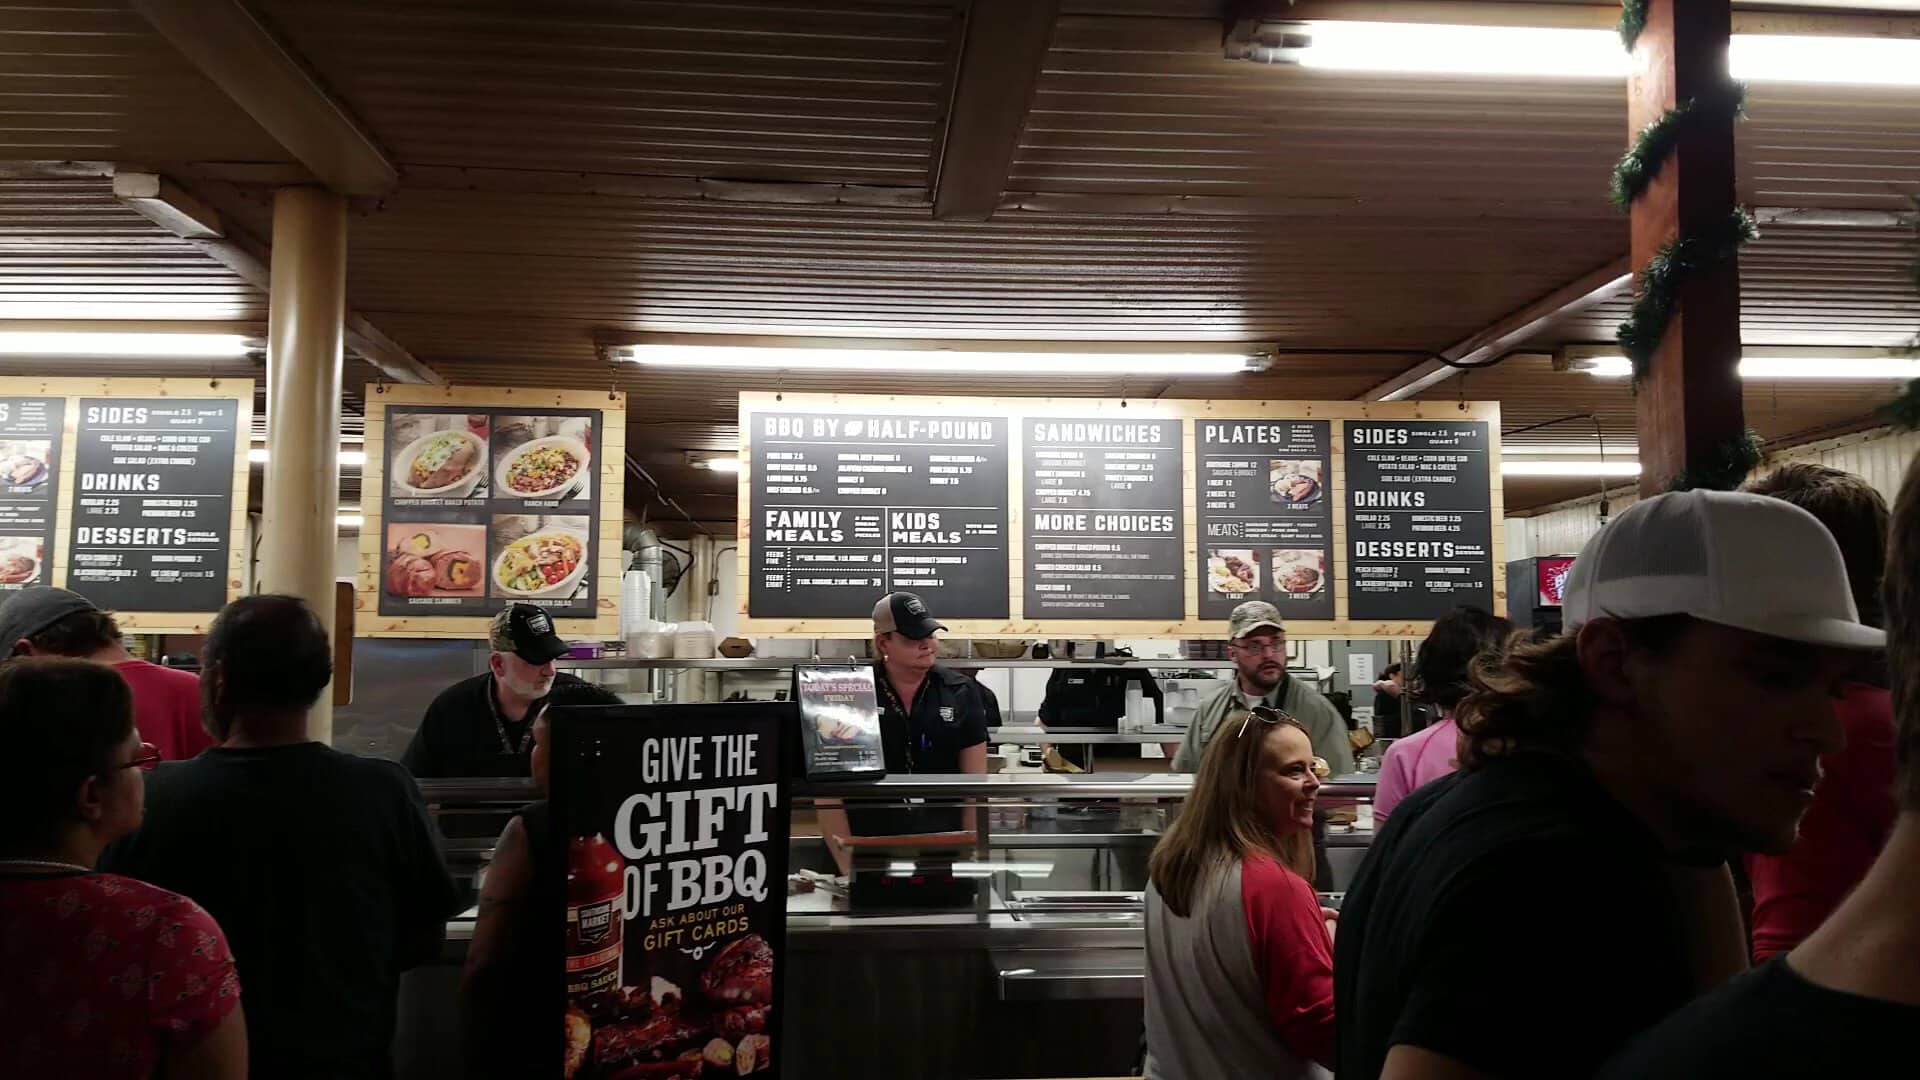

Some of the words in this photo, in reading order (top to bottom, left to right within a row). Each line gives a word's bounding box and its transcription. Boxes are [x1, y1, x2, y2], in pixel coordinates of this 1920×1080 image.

[87, 407, 147, 424] SIDES
[765, 417, 803, 439] BBQ
[813, 419, 839, 437] BY
[868, 419, 992, 439] HALF-POUND
[1034, 423, 1160, 443] SANDWICHES
[1205, 425, 1280, 443] PLATES
[1353, 429, 1408, 444] SIDES
[81, 473, 161, 491] DRINKS
[1354, 491, 1425, 506] DRINKS
[766, 511, 842, 528] FAMILY
[892, 513, 940, 530] KIDS
[1035, 514, 1087, 531] MORE
[1094, 515, 1173, 532] CHOICES
[77, 527, 187, 545] DESSERTS
[766, 530, 844, 542] MEALS
[892, 532, 961, 543] MEALS
[1207, 523, 1239, 536] MEATS
[1355, 542, 1454, 557] DESSERTS
[641, 736, 703, 783] GIVE
[710, 734, 759, 778] THE
[614, 783, 778, 860] GIFT
[623, 862, 661, 920] OF
[666, 849, 768, 911] BBQ
[650, 918, 675, 930] ASK
[679, 908, 718, 925] ABOUT
[722, 903, 745, 916] OUR
[644, 929, 684, 951] GIFT
[691, 916, 749, 941] CARDS
